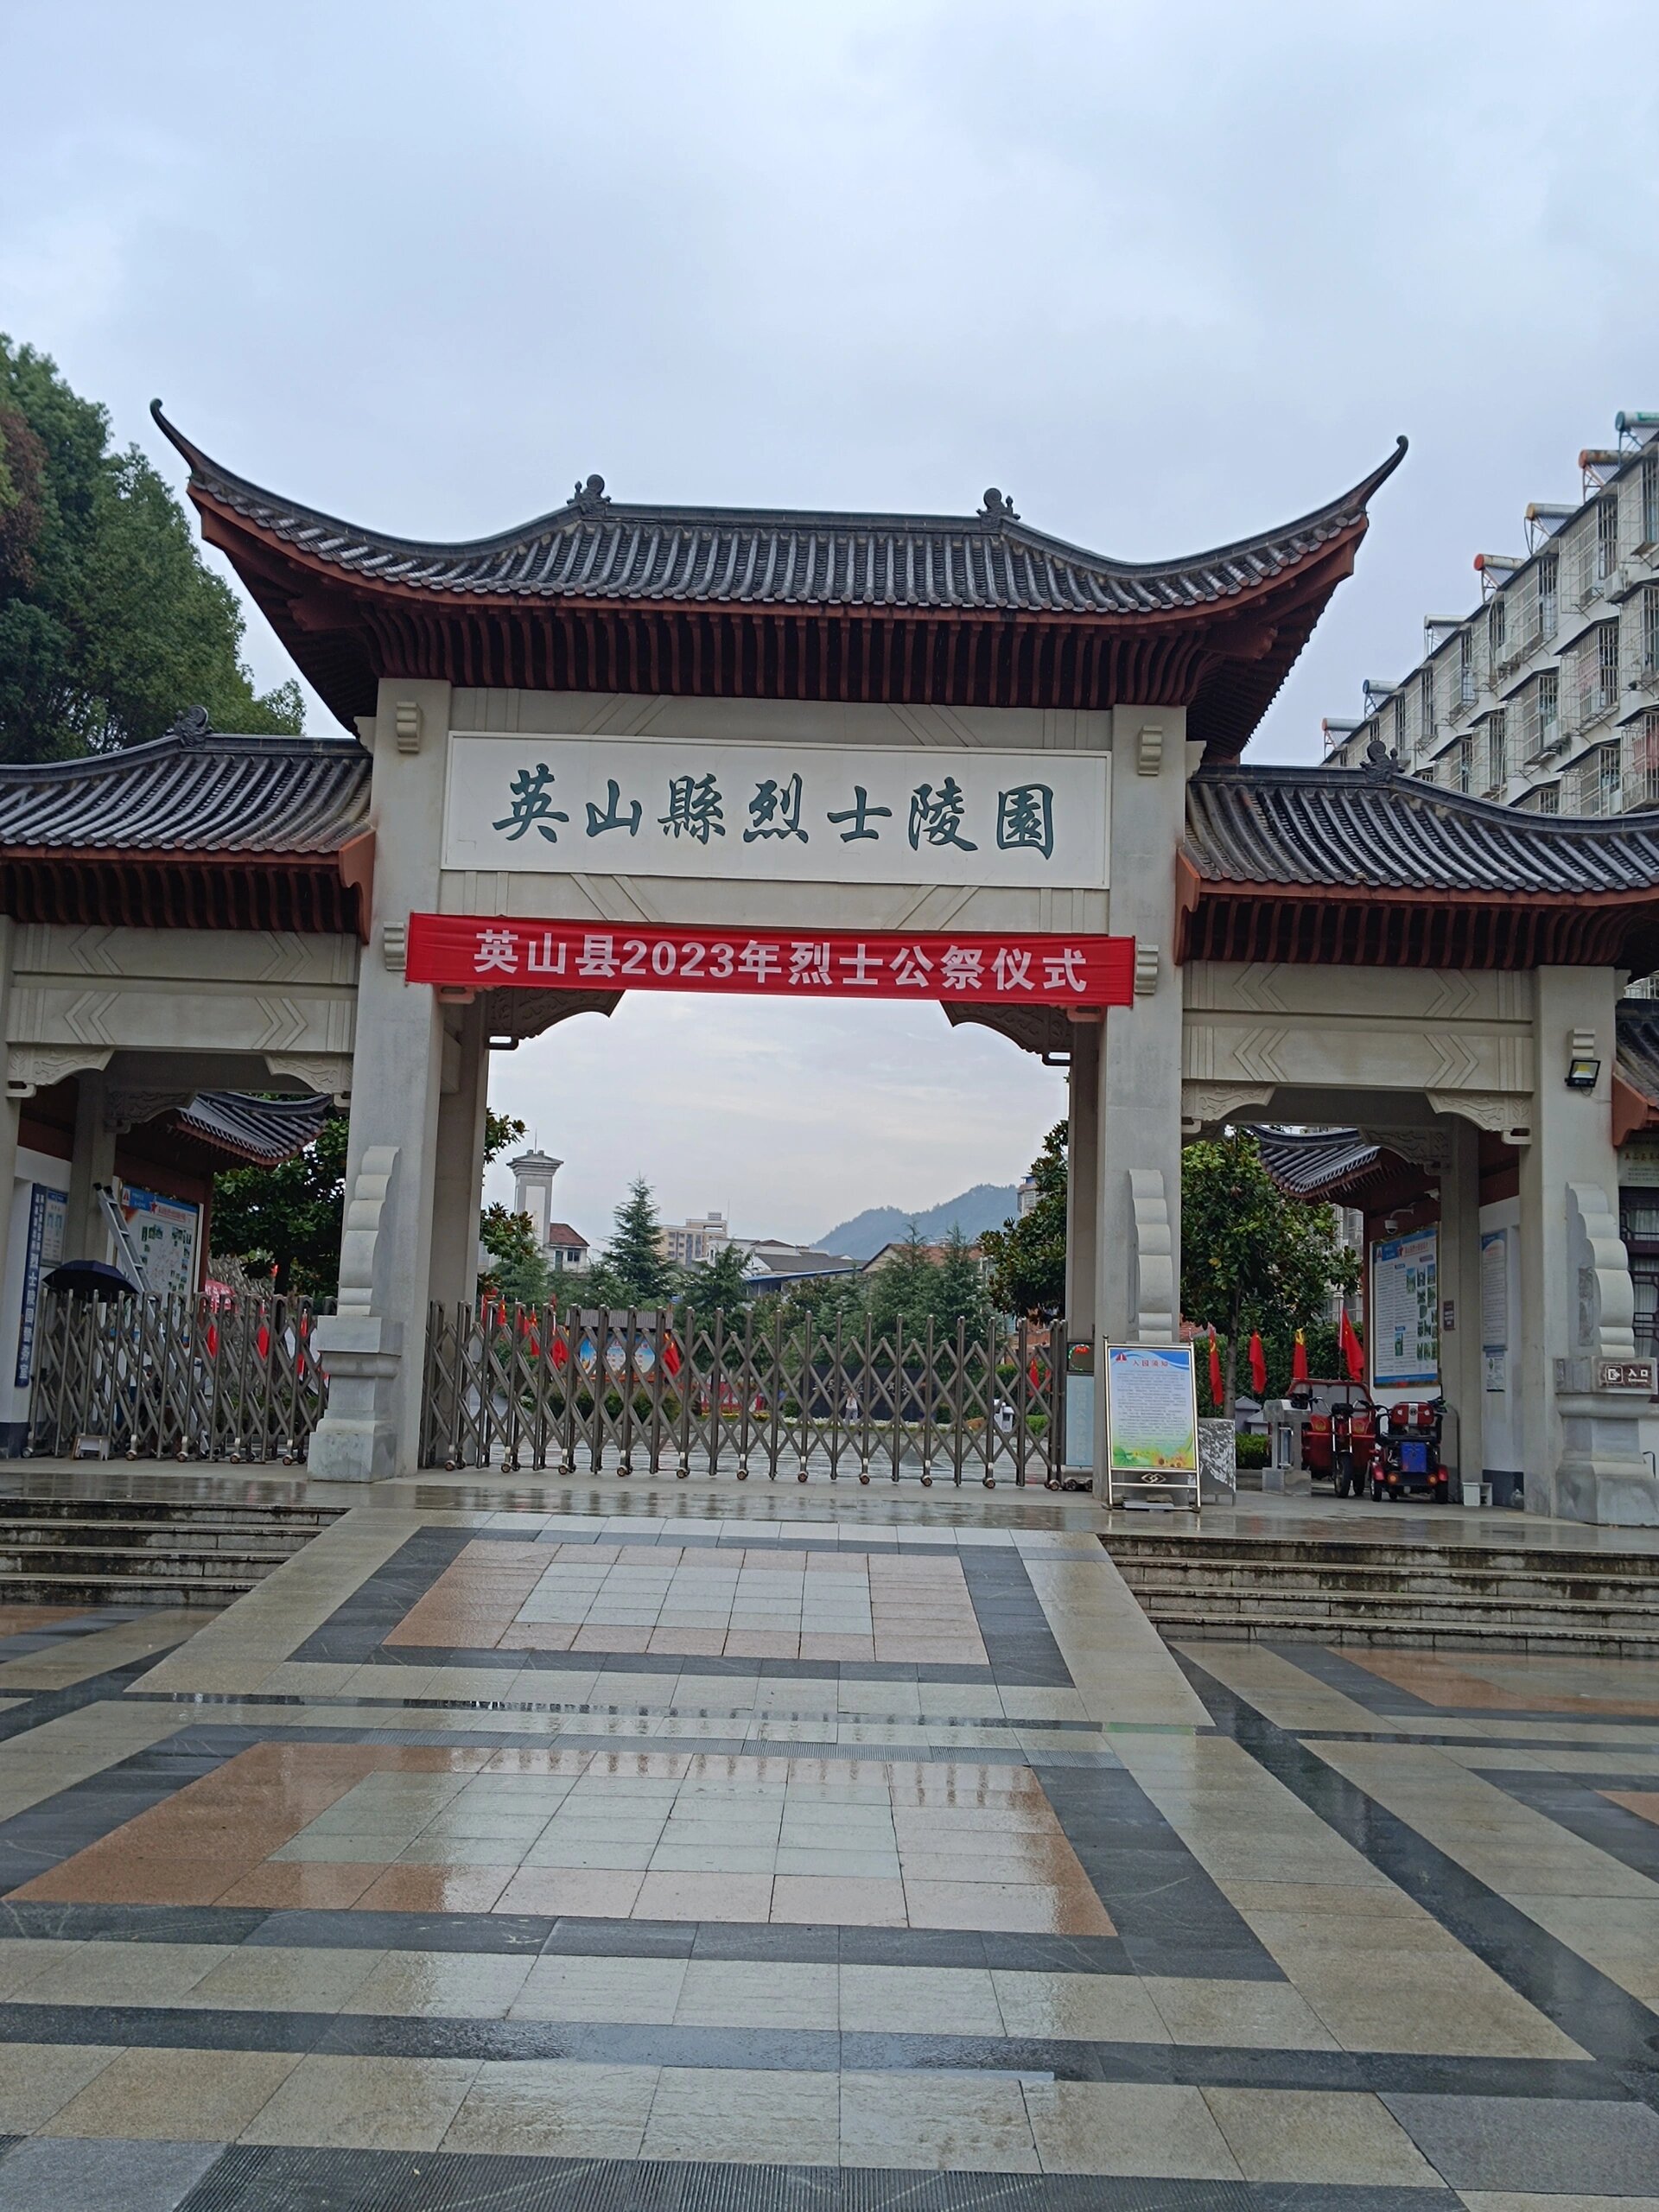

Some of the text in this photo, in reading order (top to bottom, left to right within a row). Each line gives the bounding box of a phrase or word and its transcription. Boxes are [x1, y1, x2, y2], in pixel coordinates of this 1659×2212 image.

[474, 929, 1087, 993] 英山县2023年烈士公祭仪式
[1628, 1368, 1649, 1377] 入口
